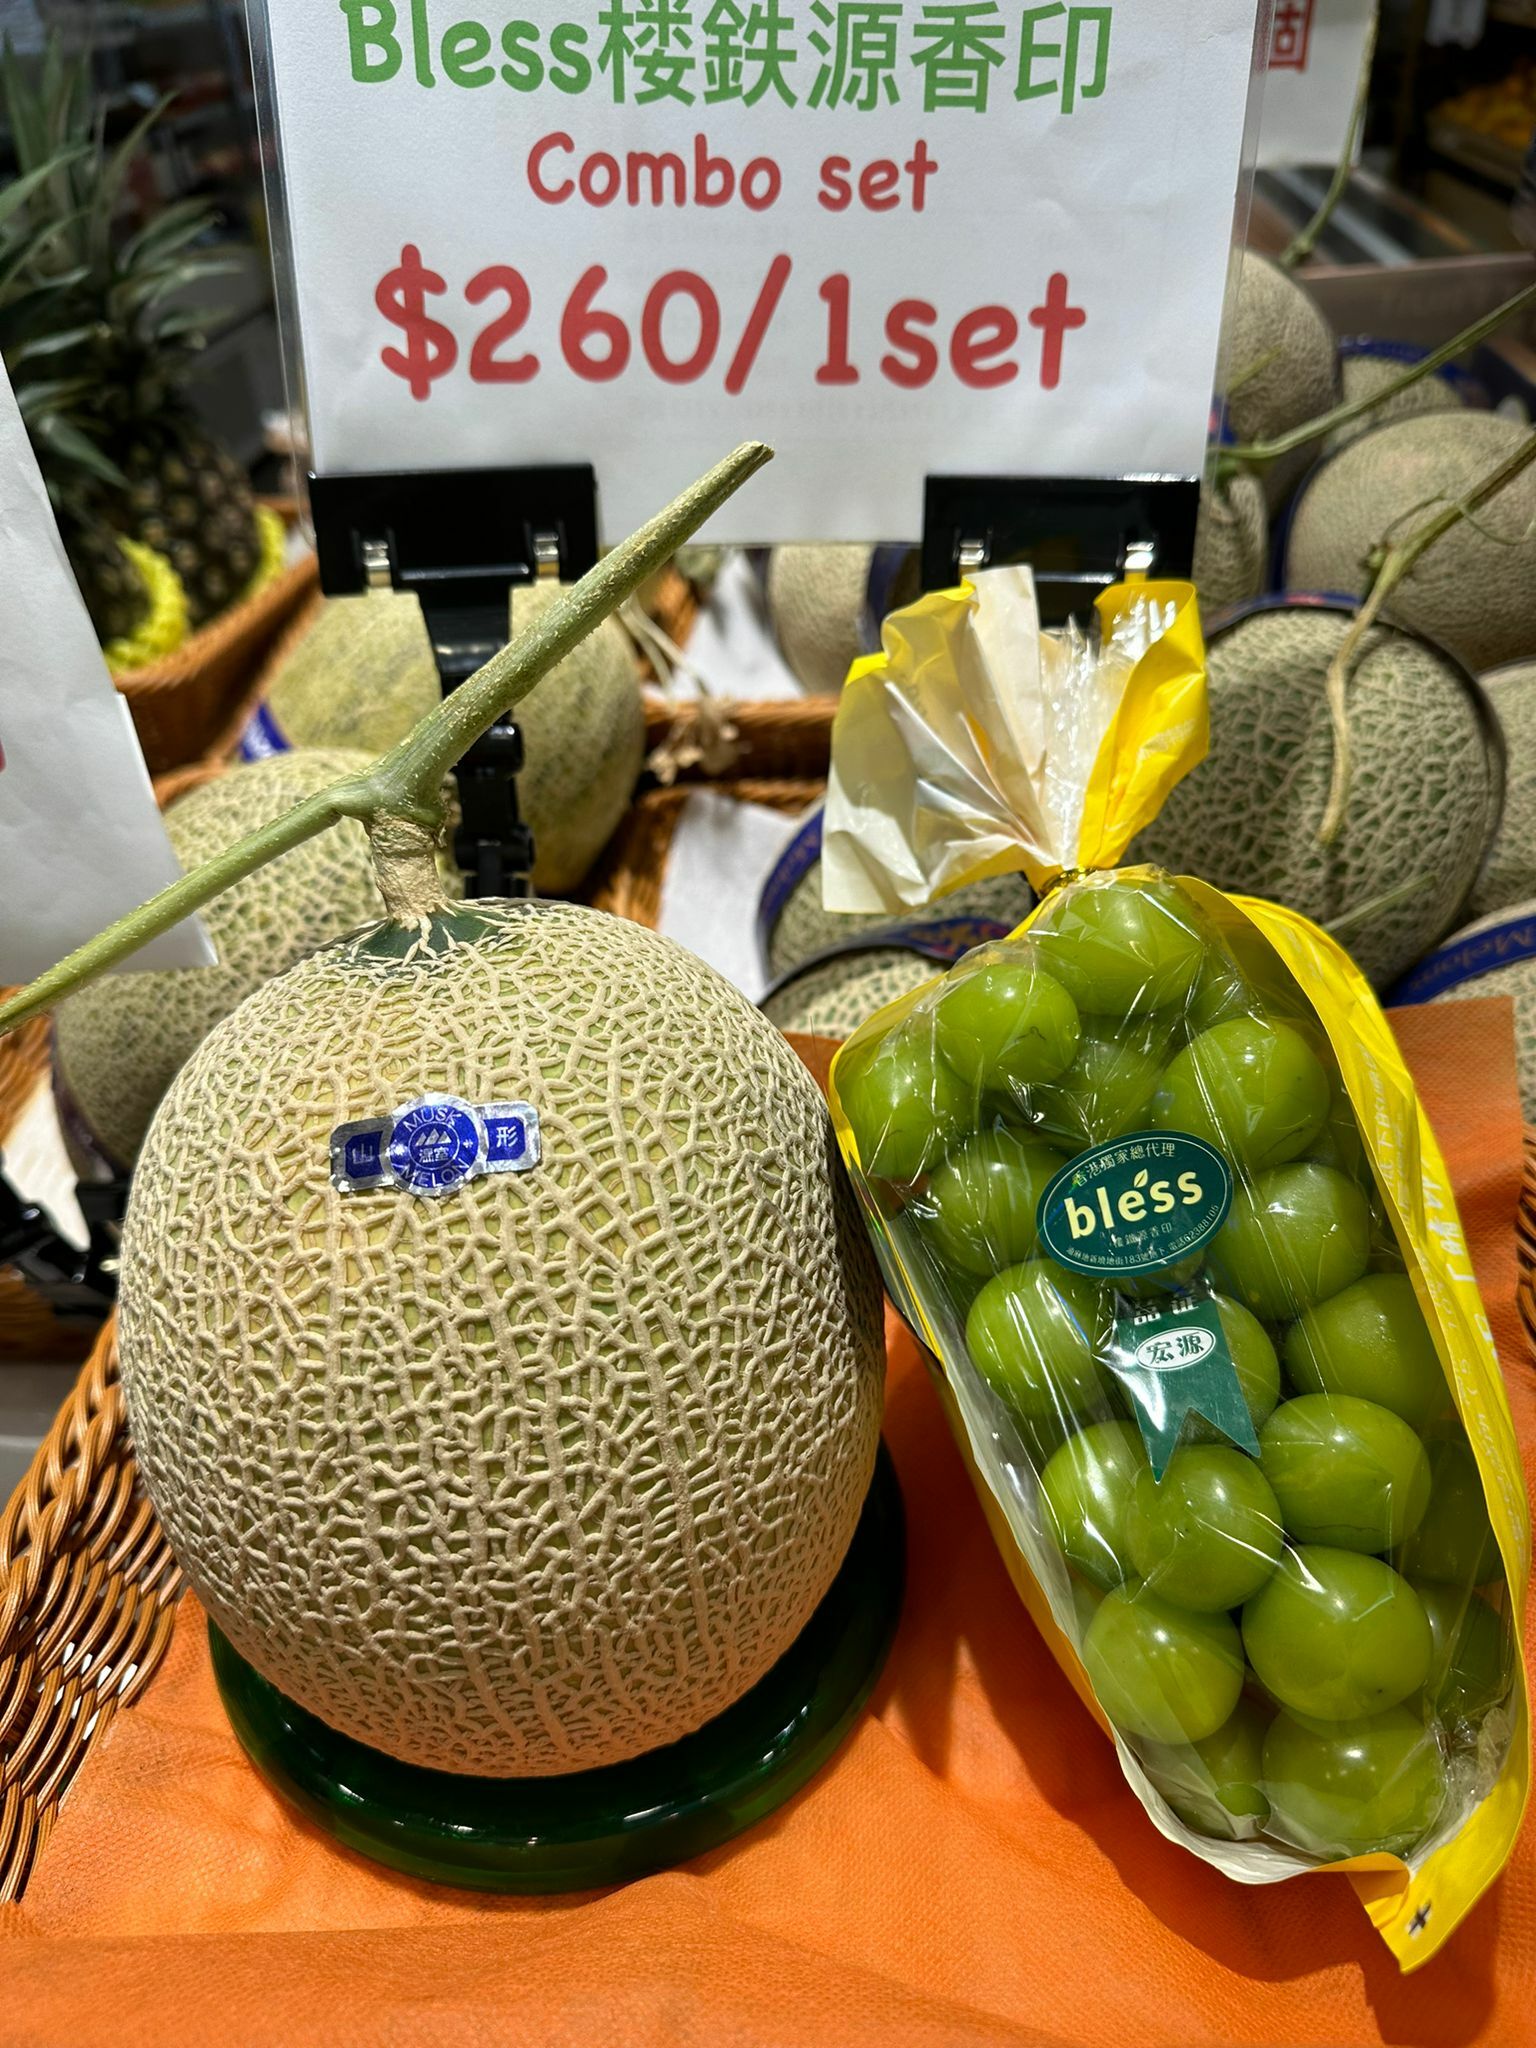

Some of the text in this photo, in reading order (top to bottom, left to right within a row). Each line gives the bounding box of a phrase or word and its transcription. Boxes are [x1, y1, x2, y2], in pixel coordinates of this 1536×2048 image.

[526, 131, 939, 212] Combo set
[374, 243, 1087, 402] $260/1set
[403, 1106, 463, 1134] MUSK
[496, 1125, 518, 1149] 形
[1145, 1332, 1205, 1366] 宏源
